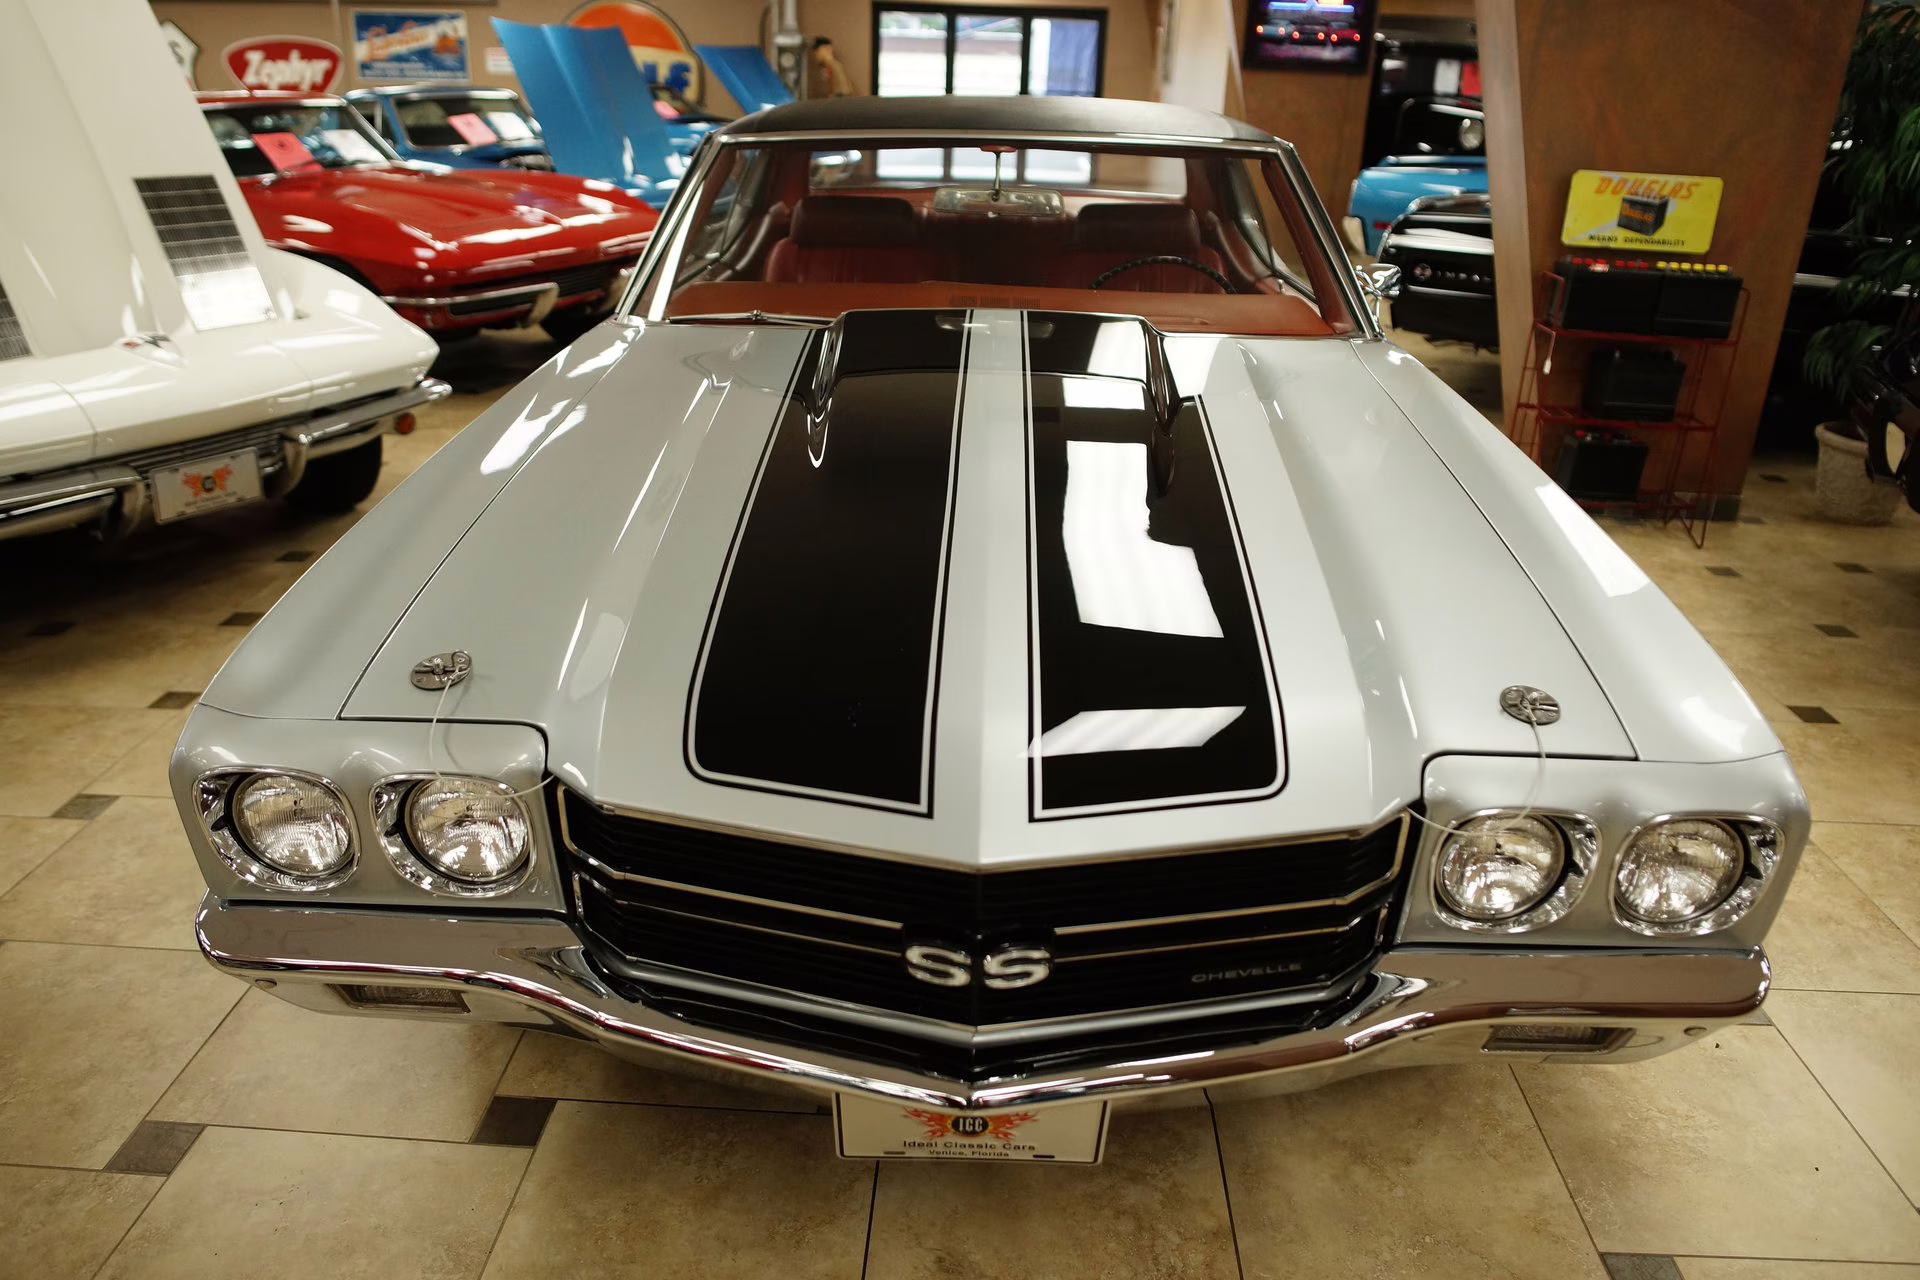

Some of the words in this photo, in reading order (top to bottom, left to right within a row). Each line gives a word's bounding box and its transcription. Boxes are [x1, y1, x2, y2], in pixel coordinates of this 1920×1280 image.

[241, 48, 333, 92] Zephyr
[1595, 176, 1700, 199] DOUGLAS
[1589, 234, 1618, 244] MEANS
[1624, 235, 1685, 247] DEPENDABILITY
[905, 945, 1050, 990] SS
[1191, 963, 1302, 983] CHEVELLE
[959, 1118, 983, 1132] ICC
[903, 1140, 938, 1149] Ideal
[943, 1141, 997, 1150] Classic
[1002, 1143, 1036, 1151] Cars
[929, 1149, 967, 1157] Venice,
[971, 1150, 1010, 1158] Florida
